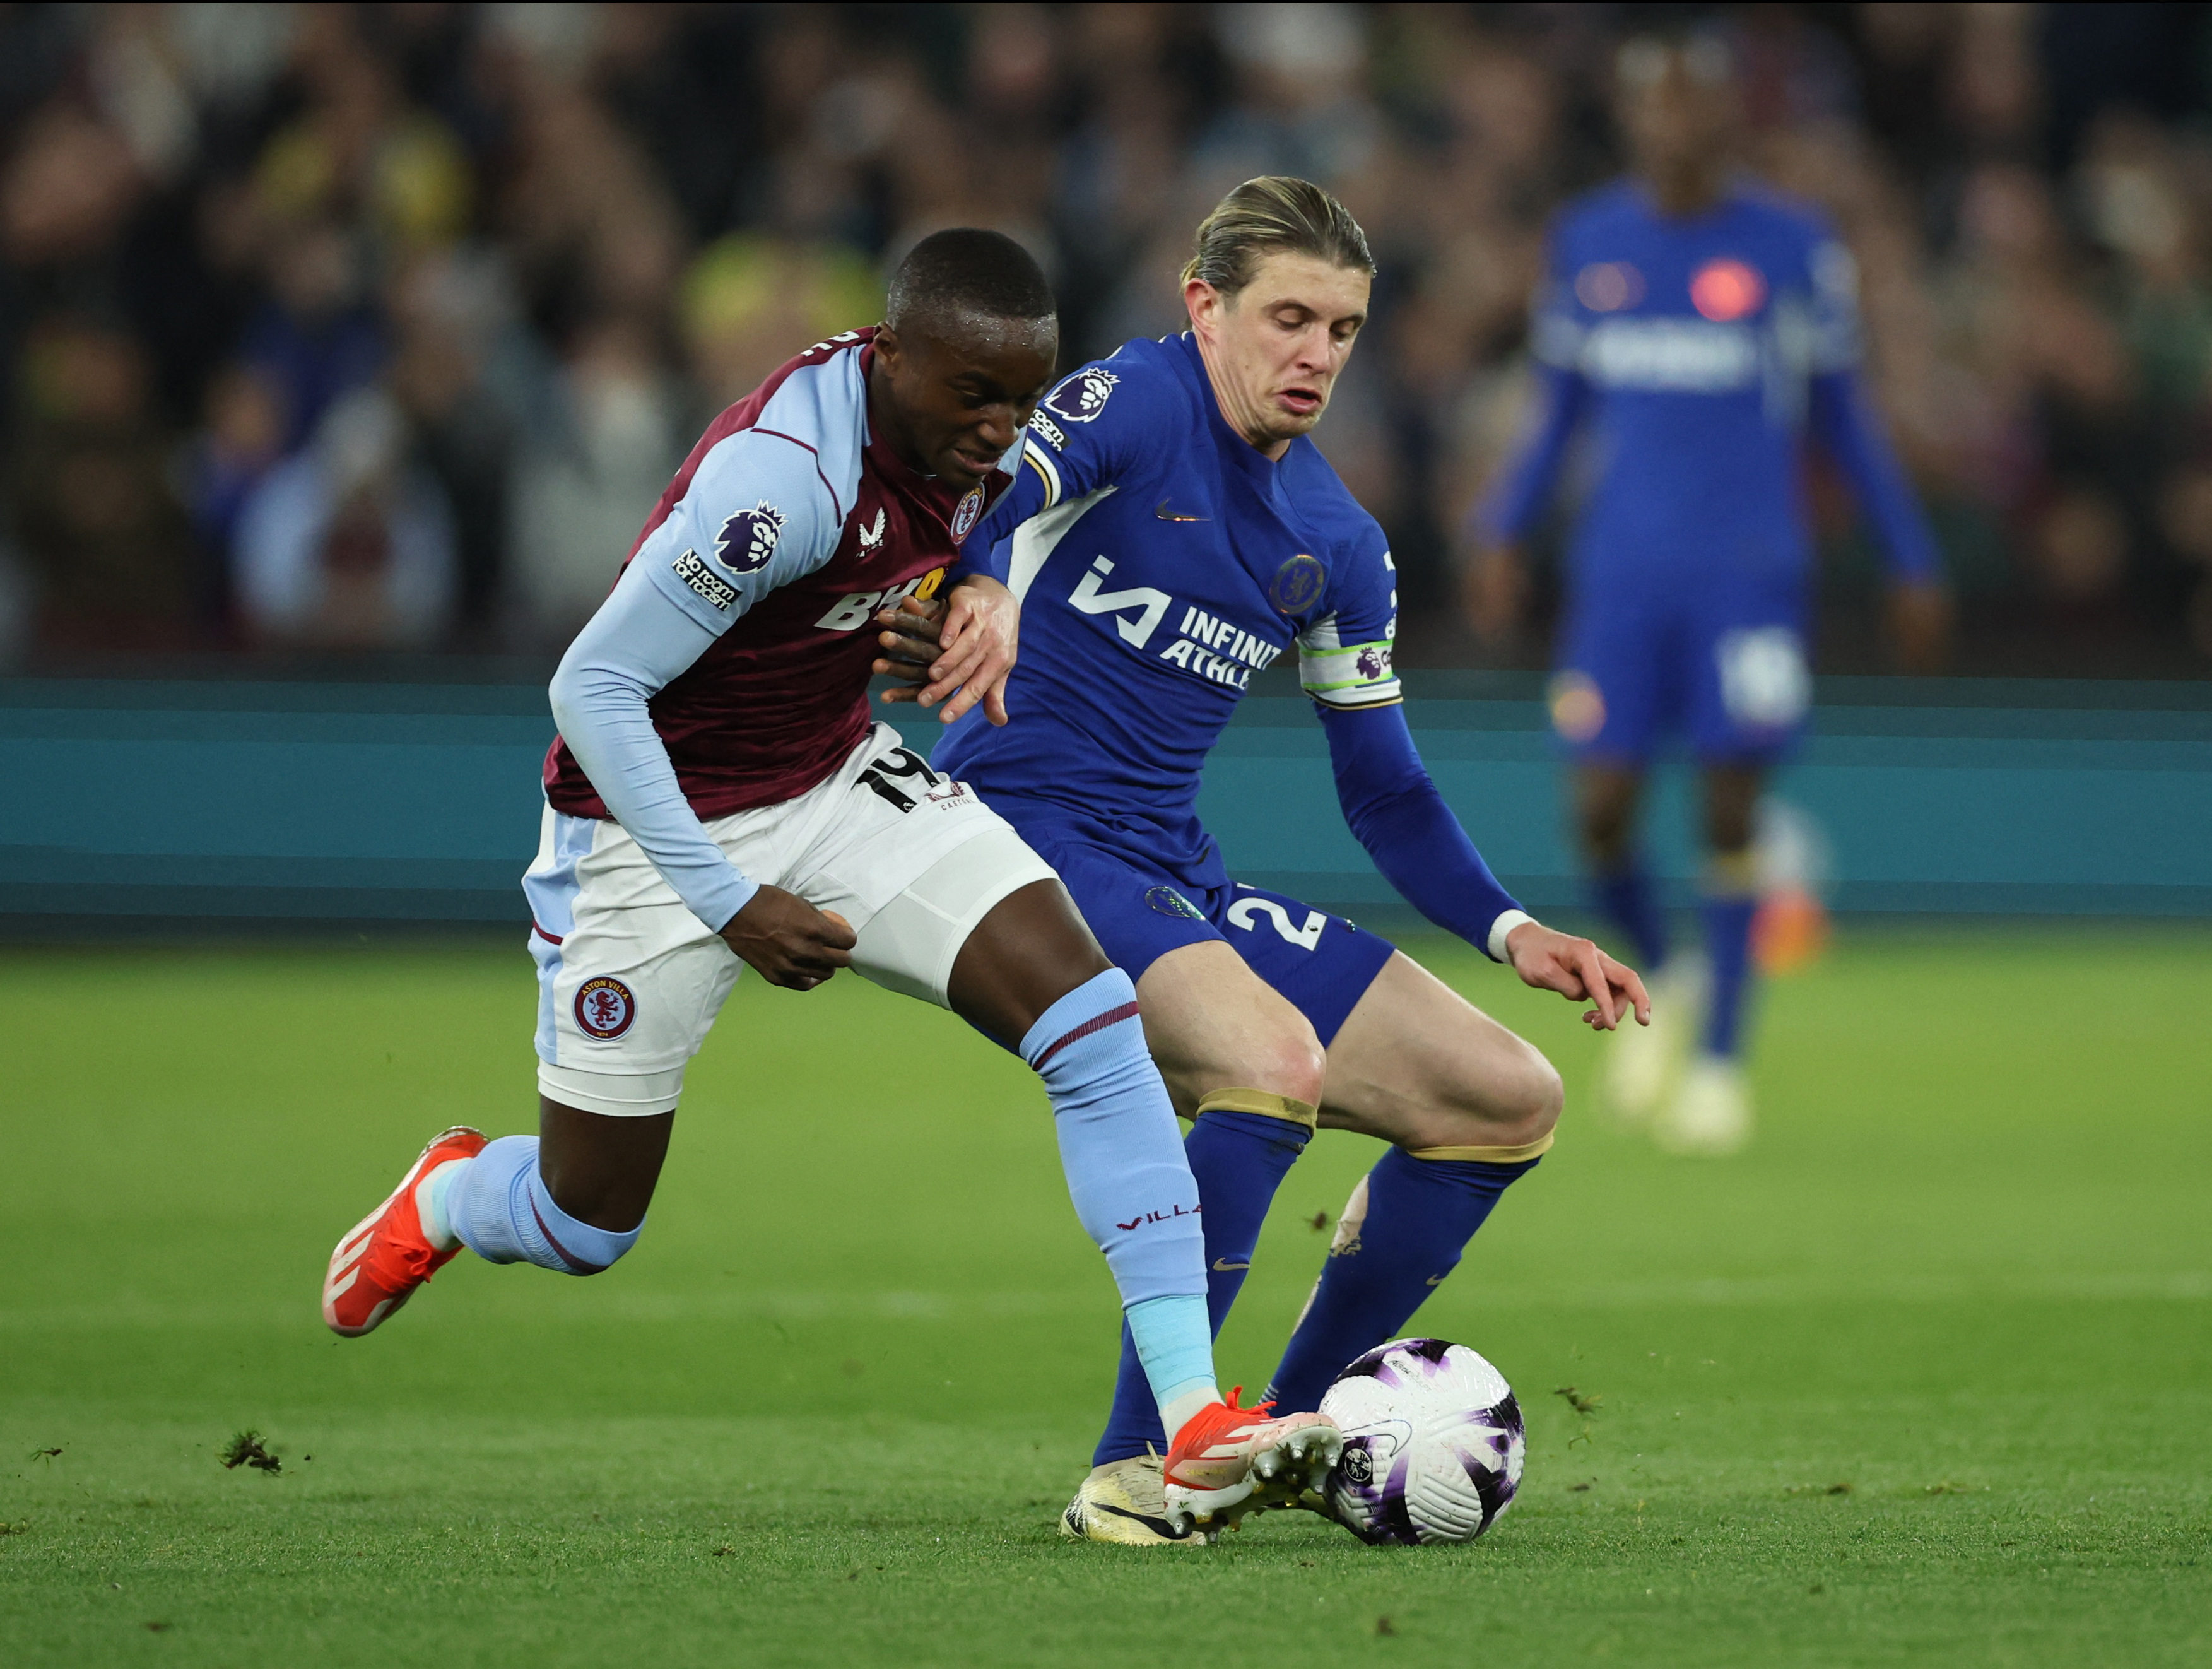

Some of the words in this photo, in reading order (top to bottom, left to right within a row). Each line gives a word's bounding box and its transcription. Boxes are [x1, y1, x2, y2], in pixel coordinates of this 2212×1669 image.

[1028, 417, 1062, 452] acism
[671, 556, 693, 579] for
[688, 576, 731, 611] racism
[680, 547, 702, 572] No
[697, 569, 736, 601] room
[1179, 606, 1283, 671] INFINIT
[1227, 882, 1327, 952] 2
[582, 980, 606, 996] ASTON
[609, 981, 629, 1000] VILLA
